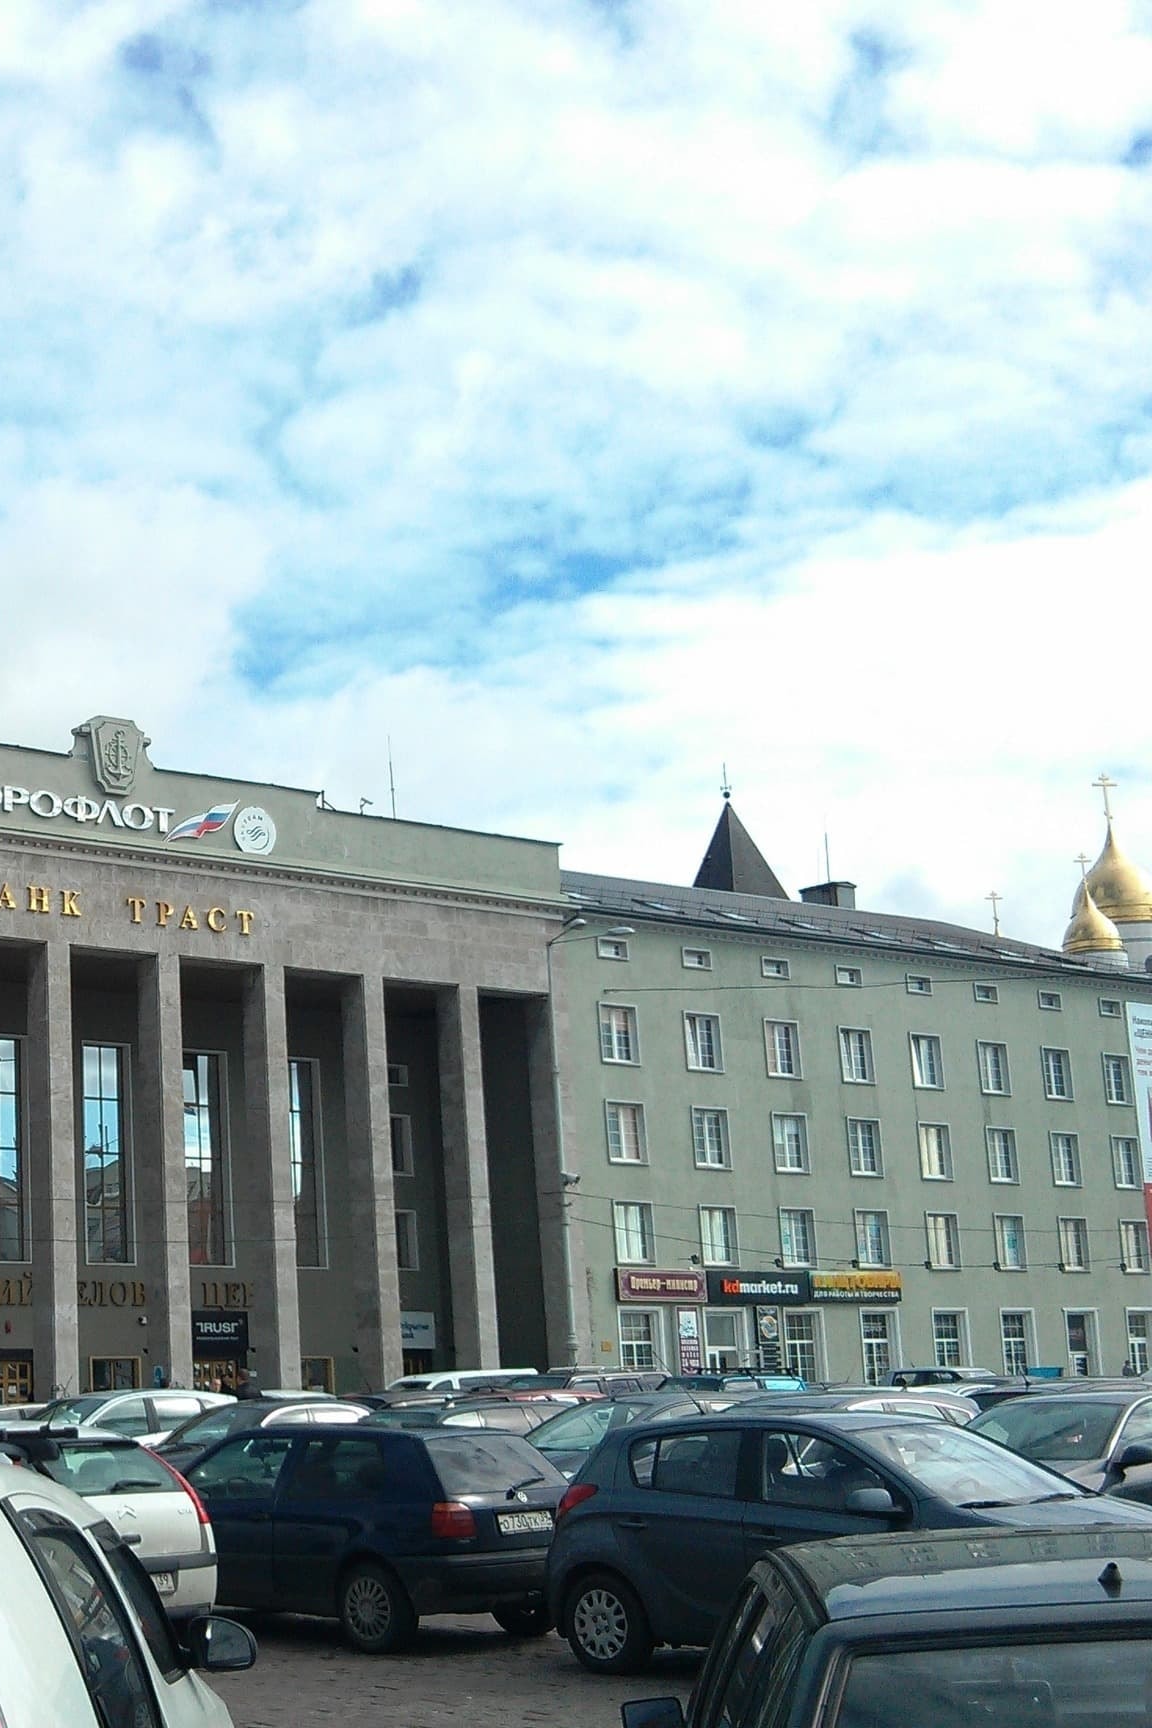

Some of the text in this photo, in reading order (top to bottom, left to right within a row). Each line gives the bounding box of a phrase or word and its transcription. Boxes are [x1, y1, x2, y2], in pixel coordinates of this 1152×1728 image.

[127, 897, 255, 936] ТРАСТ
[723, 1279, 799, 1295] kdmarket.ru
[195, 1321, 239, 1333] TRUST
